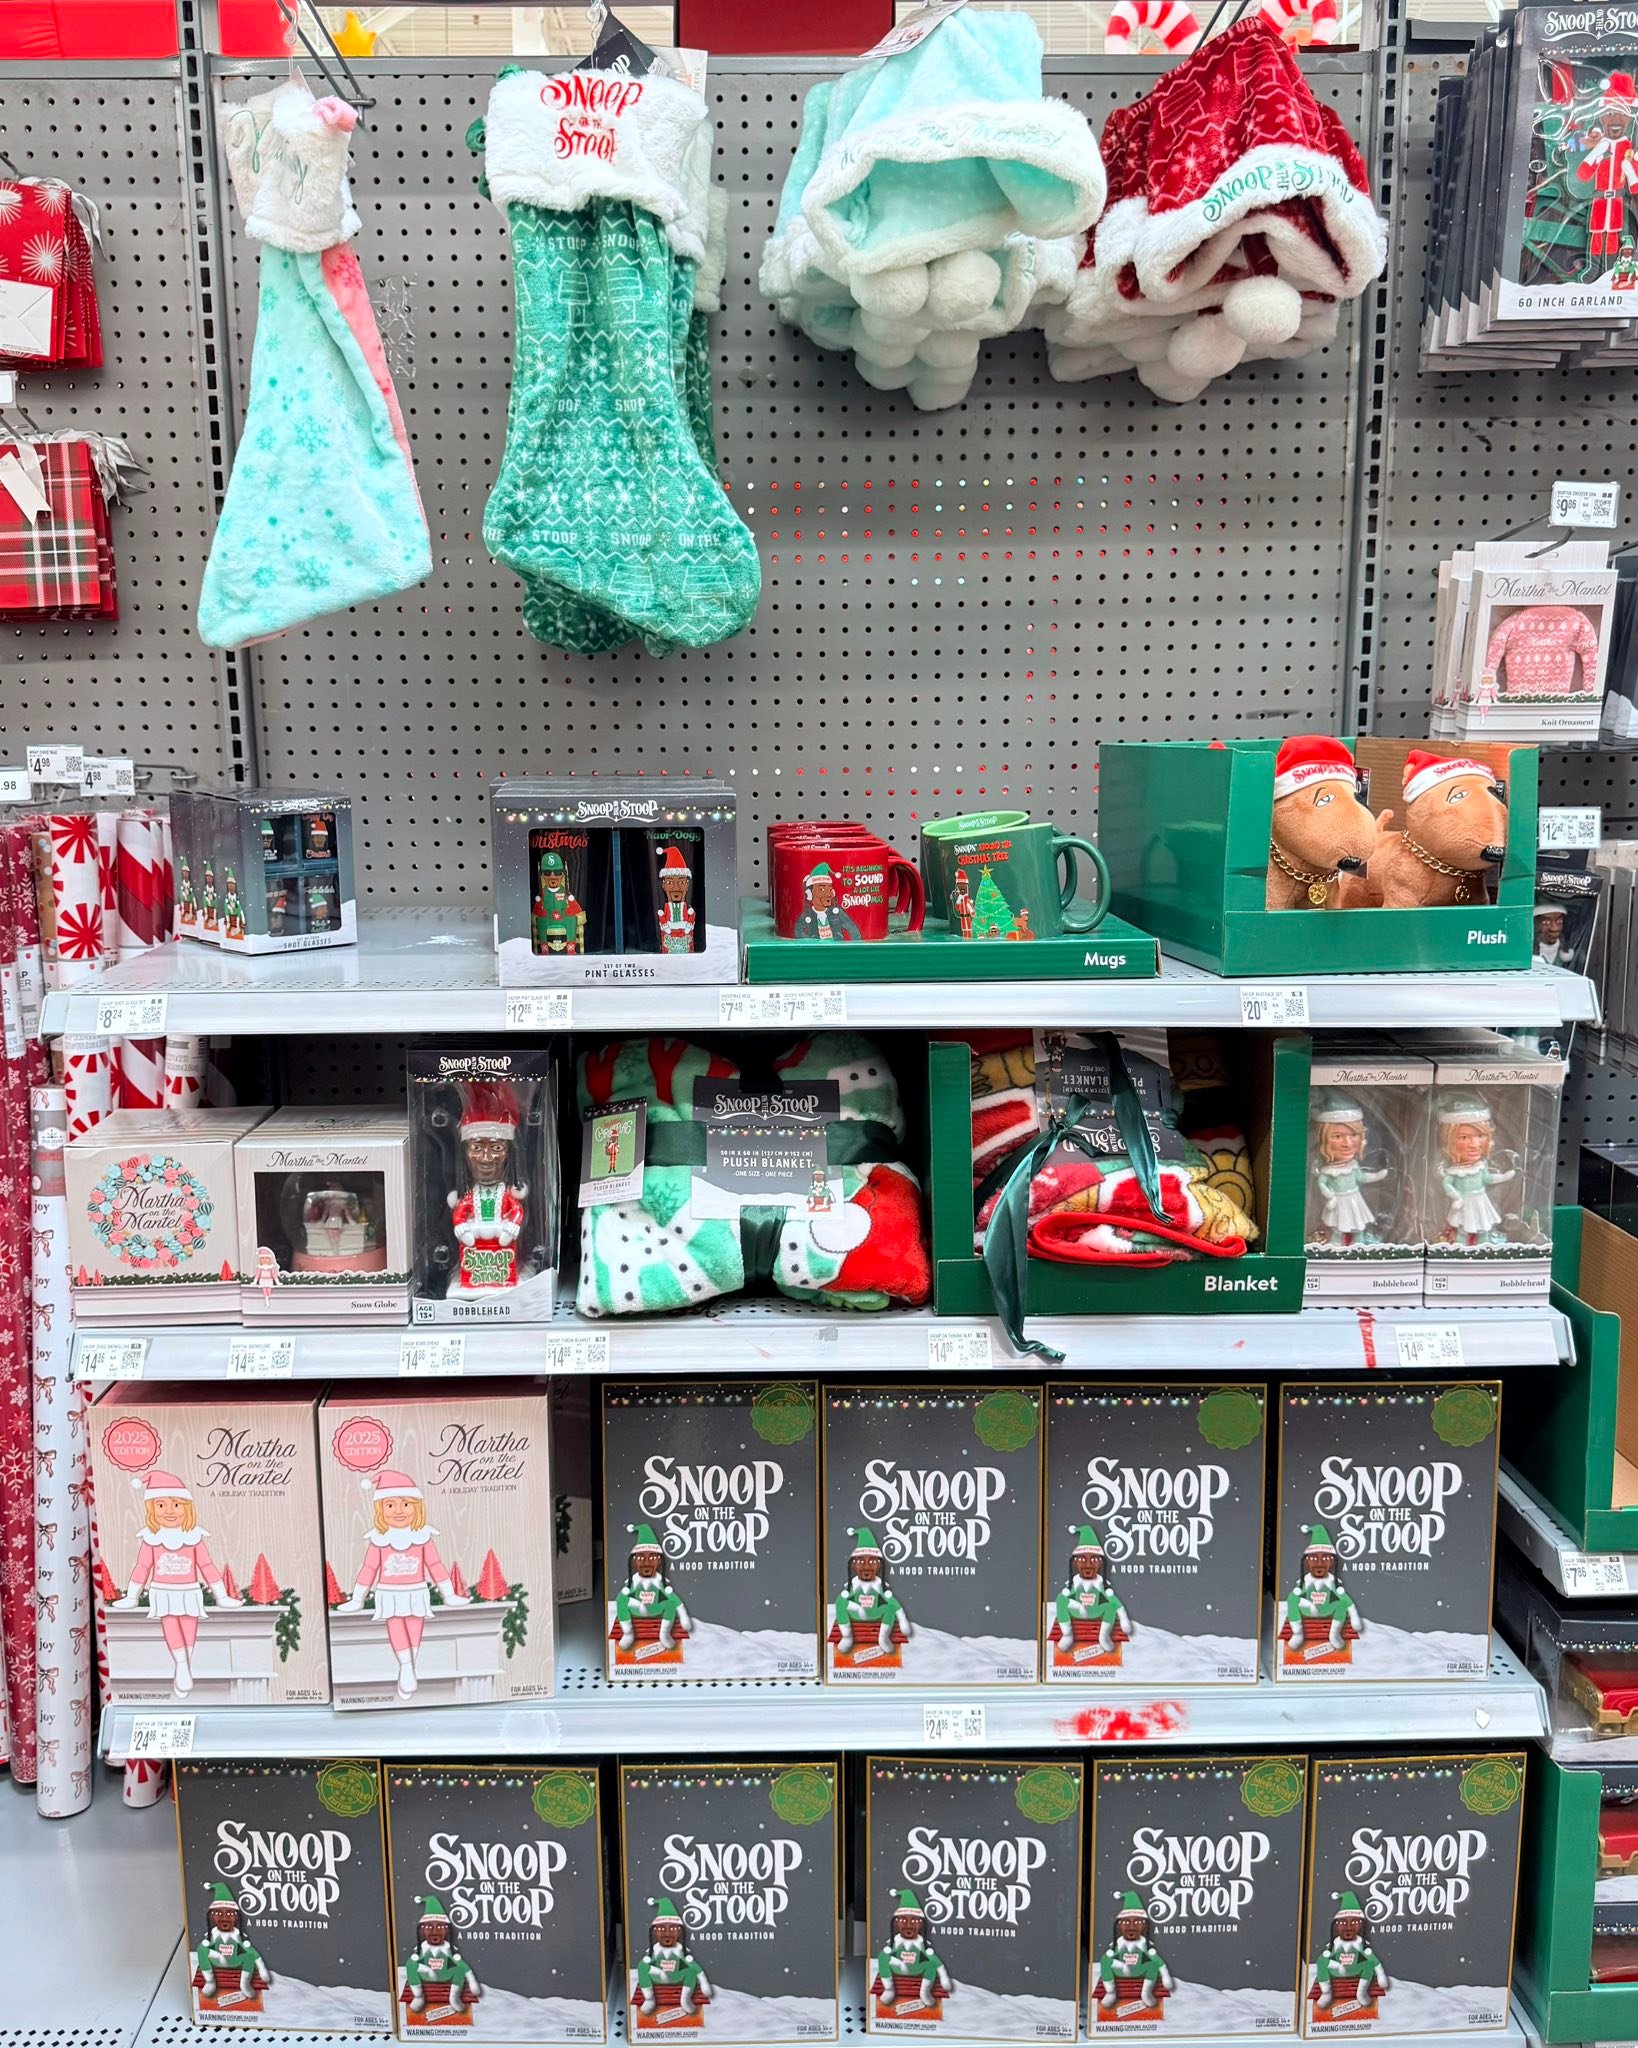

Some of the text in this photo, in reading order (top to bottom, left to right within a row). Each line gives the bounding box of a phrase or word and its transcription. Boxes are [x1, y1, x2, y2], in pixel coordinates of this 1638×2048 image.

[1544, 11, 1596, 36] SNOOP
[1604, 8, 1638, 33] STO
[540, 75, 644, 117] SNOOP
[1203, 164, 1273, 222] SNOOP
[1518, 295, 1623, 308] 60 INCH GARLAND
[1486, 577, 1612, 600] Martha Mantel
[1558, 719, 1594, 727] Ornament
[575, 800, 658, 818] SNOOP STOOP
[958, 852, 1008, 866] CHRISTMAS TREE
[842, 872, 884, 886] TO SOUND
[284, 941, 300, 950] SHOT
[303, 938, 332, 948] GLASSES
[1467, 930, 1507, 945] Plush
[1084, 952, 1126, 966] Mugs
[585, 968, 655, 978] PINT GLASSES
[439, 1056, 512, 1071] SNOOP STOOP
[1333, 1070, 1408, 1082] Martha Mantel
[1464, 1069, 1540, 1082] Martha Mantel
[713, 1094, 820, 1114] SNOOP STOOP
[266, 1150, 368, 1168] Martha Mantel
[723, 1157, 812, 1168] PLUSH BLANKET
[120, 1185, 184, 1209] Martha
[34, 1200, 50, 1214] joy
[161, 1208, 176, 1216] the
[120, 1211, 183, 1230] Mantel
[461, 1248, 514, 1270] SNOOP
[34, 1274, 50, 1288] joy
[1204, 1276, 1278, 1292] Blanket
[1372, 1279, 1418, 1288] Bobblehead
[1500, 1279, 1546, 1288] Bobblehead
[419, 1312, 433, 1320] 13+
[452, 1306, 510, 1316] BOBBLEHEAD
[36, 1348, 52, 1362] joy
[37, 1420, 52, 1435] joy
[114, 1432, 150, 1444] 2025
[196, 1428, 298, 1460] Martha
[345, 1430, 381, 1444] 2025
[429, 1424, 530, 1457] Martha
[114, 1446, 150, 1456] EDITION
[345, 1446, 382, 1456] EDITION
[480, 1452, 516, 1464] on the
[246, 1459, 284, 1470] on the
[196, 1462, 292, 1488] Mantel
[428, 1458, 524, 1486] Mantel
[210, 1490, 286, 1498] A HOLIDAY TRADITION
[450, 1486, 478, 1494] HOLIDAY
[480, 1484, 518, 1493] TRADITION
[639, 1455, 784, 1519] SNOOP
[859, 1458, 1006, 1522] SNOOP
[1081, 1456, 1230, 1520] SNOOP
[1314, 1456, 1463, 1520] SNOOP
[694, 1507, 735, 1520] ON THE
[914, 1512, 956, 1526] ON THE
[1137, 1510, 1179, 1524] ON THE
[1369, 1508, 1412, 1522] ON THE
[662, 1512, 770, 1560] STOOP
[882, 1517, 990, 1564] STOOP
[1104, 1514, 1214, 1562] STOOP
[1336, 1513, 1446, 1561] STOOP
[670, 1561, 755, 1570] A HOOD TRADITION
[615, 1668, 644, 1676] WARNING
[833, 1672, 862, 1680] WARNING
[214, 1820, 352, 1880] SNOOP
[902, 1826, 1047, 1888] SNOOP
[1126, 1827, 1270, 1886] SNOOP
[1345, 1827, 1488, 1886] SNOOP
[425, 1832, 566, 1891] SNOOP
[659, 1834, 803, 1892] SNOOP
[268, 1870, 307, 1884] ON THE
[956, 1877, 998, 1890] ON THE
[1180, 1874, 1221, 1888] ON THE
[1398, 1873, 1438, 1886] ON THE
[480, 1882, 520, 1894] ON THE
[714, 1882, 755, 1894] ON THE
[238, 1874, 340, 1918] STOOP
[924, 1880, 1032, 1926] STOOP
[1147, 1880, 1254, 1924] STOOP
[1364, 1878, 1470, 1924] STOOP
[449, 1886, 554, 1930] STOOP
[682, 1887, 789, 1930] STOOP
[256, 1919, 278, 1928] HOOD
[282, 1920, 329, 1930] TRADITION
[1380, 1924, 1403, 1934] HOOD
[1407, 1922, 1454, 1932] TRADITION
[458, 1932, 542, 1941] A HOOD TRADITION
[406, 2029, 434, 2038] WARNING
[1311, 2024, 1340, 2034] WARNING
